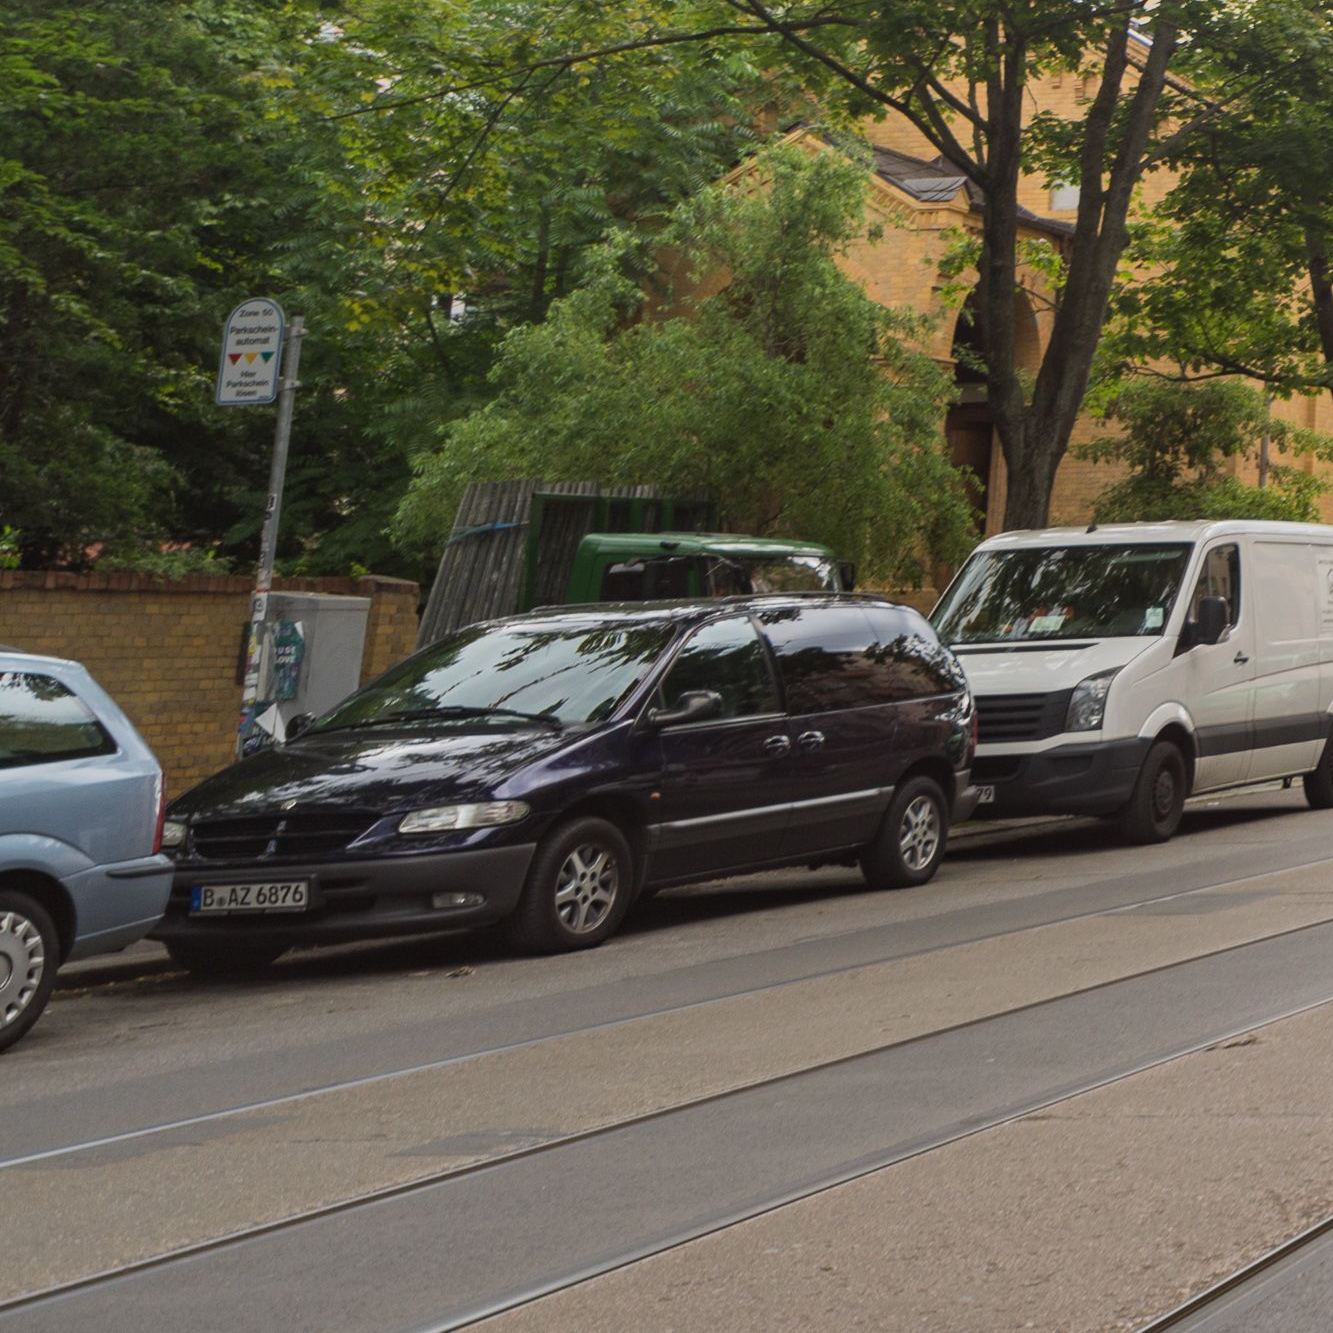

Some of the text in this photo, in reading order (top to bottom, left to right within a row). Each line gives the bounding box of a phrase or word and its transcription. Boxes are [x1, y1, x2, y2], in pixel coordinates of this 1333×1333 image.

[239, 309, 259, 317] Zone
[235, 336, 271, 346] automat
[240, 370, 257, 378] Hier
[226, 380, 270, 389] Parkschein
[235, 389, 257, 397] lösen
[202, 884, 304, 908] B AZ 6876
